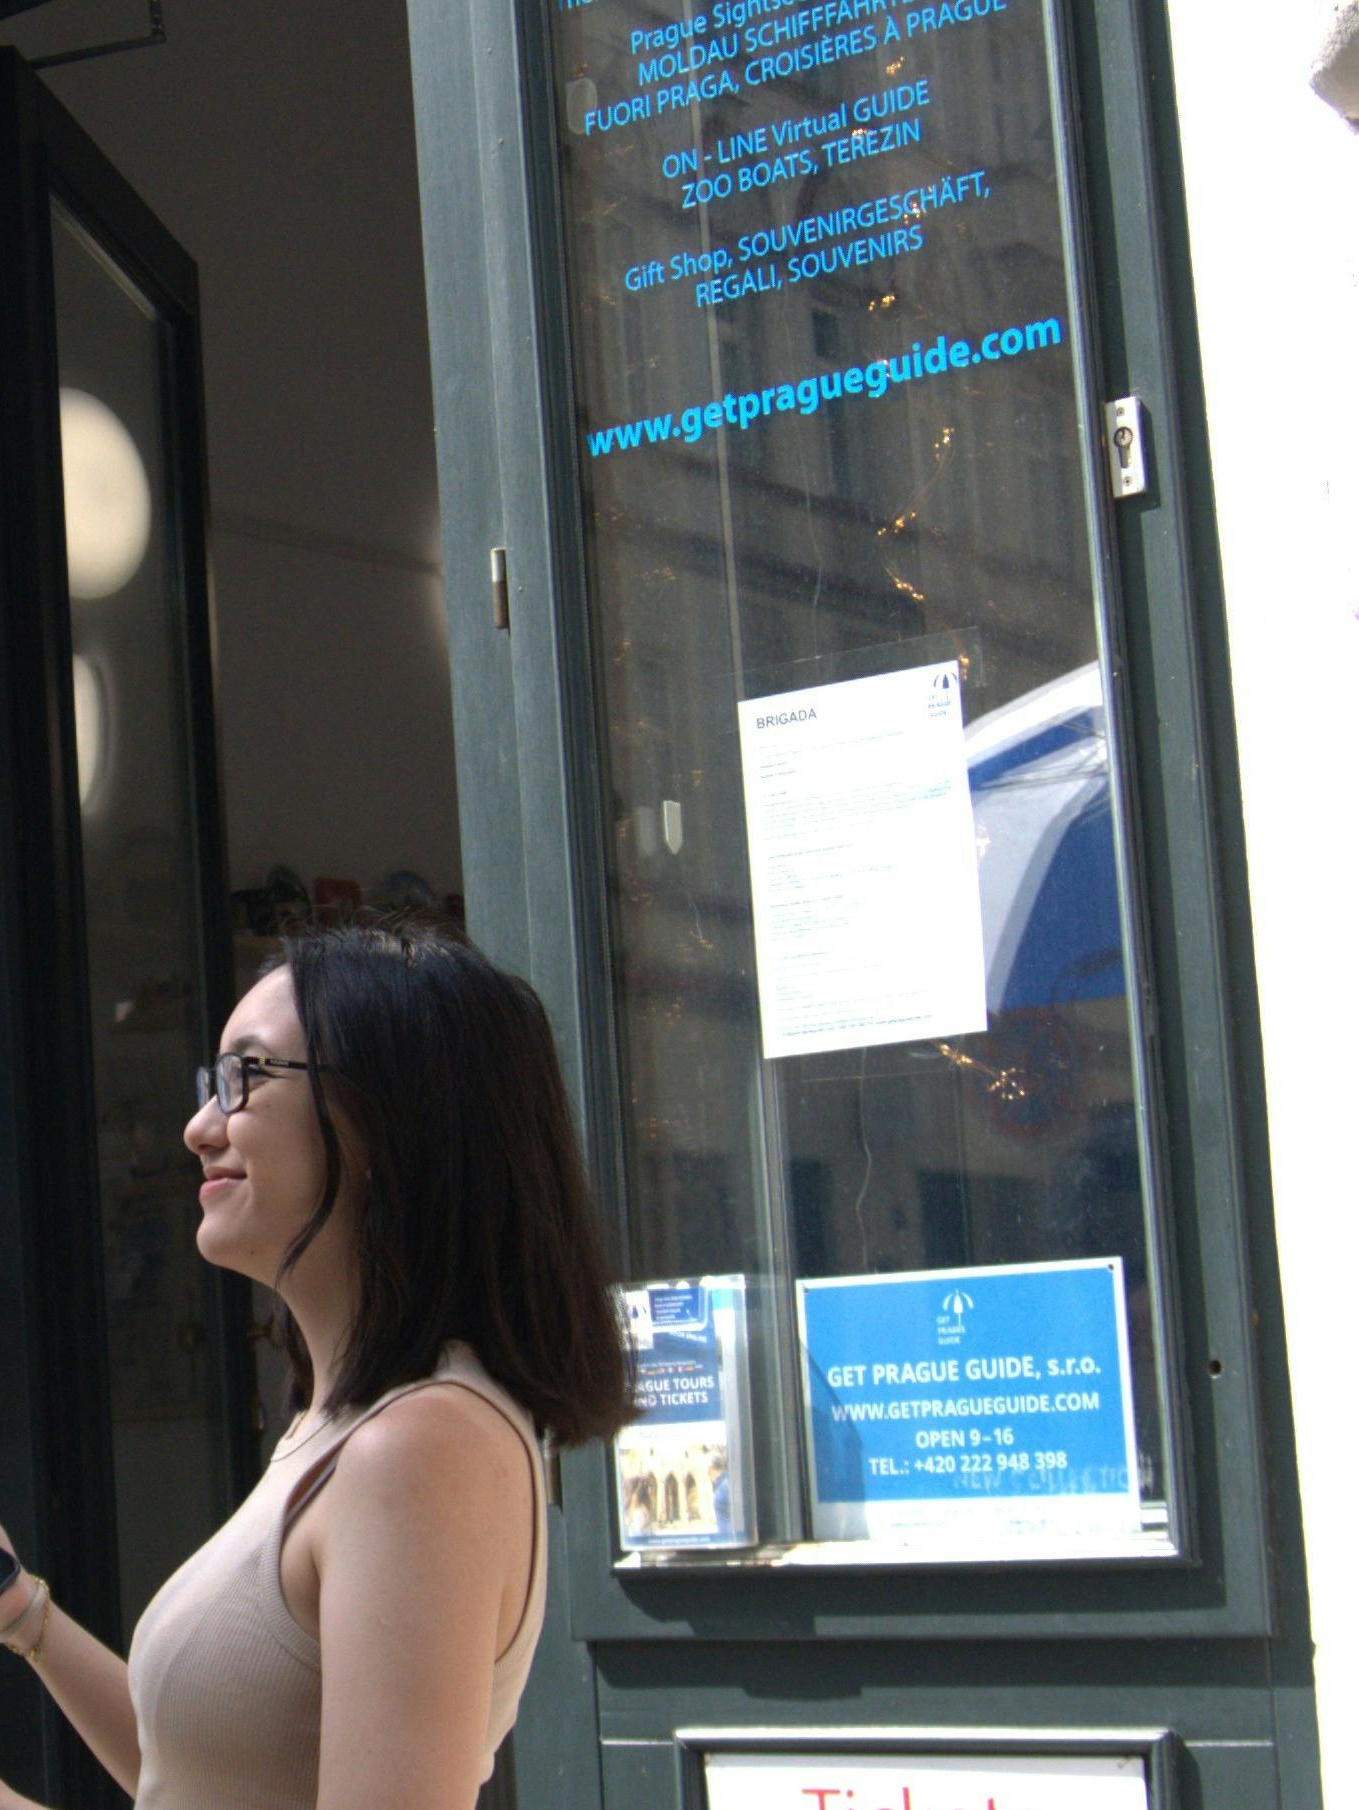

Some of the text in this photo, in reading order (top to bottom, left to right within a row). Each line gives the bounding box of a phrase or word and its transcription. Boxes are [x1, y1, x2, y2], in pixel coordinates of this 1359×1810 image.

[630, 15, 707, 55] Prague
[585, 95, 651, 136] FUORI
[657, 69, 740, 114] PRAGA,
[745, 24, 877, 86] CROISIÈRES
[883, 14, 901, 45] À
[638, 33, 739, 86] MOLDAU
[662, 149, 698, 179] ON
[718, 128, 768, 164] LINE
[771, 103, 848, 147] Virtual
[853, 79, 930, 122] GUIDE
[682, 118, 921, 209] ZOO BOATS, TEREZIN
[625, 170, 990, 291] Gift Shop, SOUVENIRGESCHÄFT,
[696, 224, 924, 307] REGALI, SOUVENIRS
[586, 317, 1061, 457] www.getpragueguide.com
[756, 708, 817, 730] BRIGADA
[672, 1375, 715, 1390] TOURS
[827, 1355, 1101, 1388] GET PRAGUE GUIDE, s.r.o.
[659, 1391, 709, 1407] TICKETS
[832, 1391, 1100, 1422] WWW.GETPRAGUEGUIDE.COM
[915, 1429, 965, 1449] OPEN
[868, 1451, 1068, 1476] TEL.: +420 222 948 398
